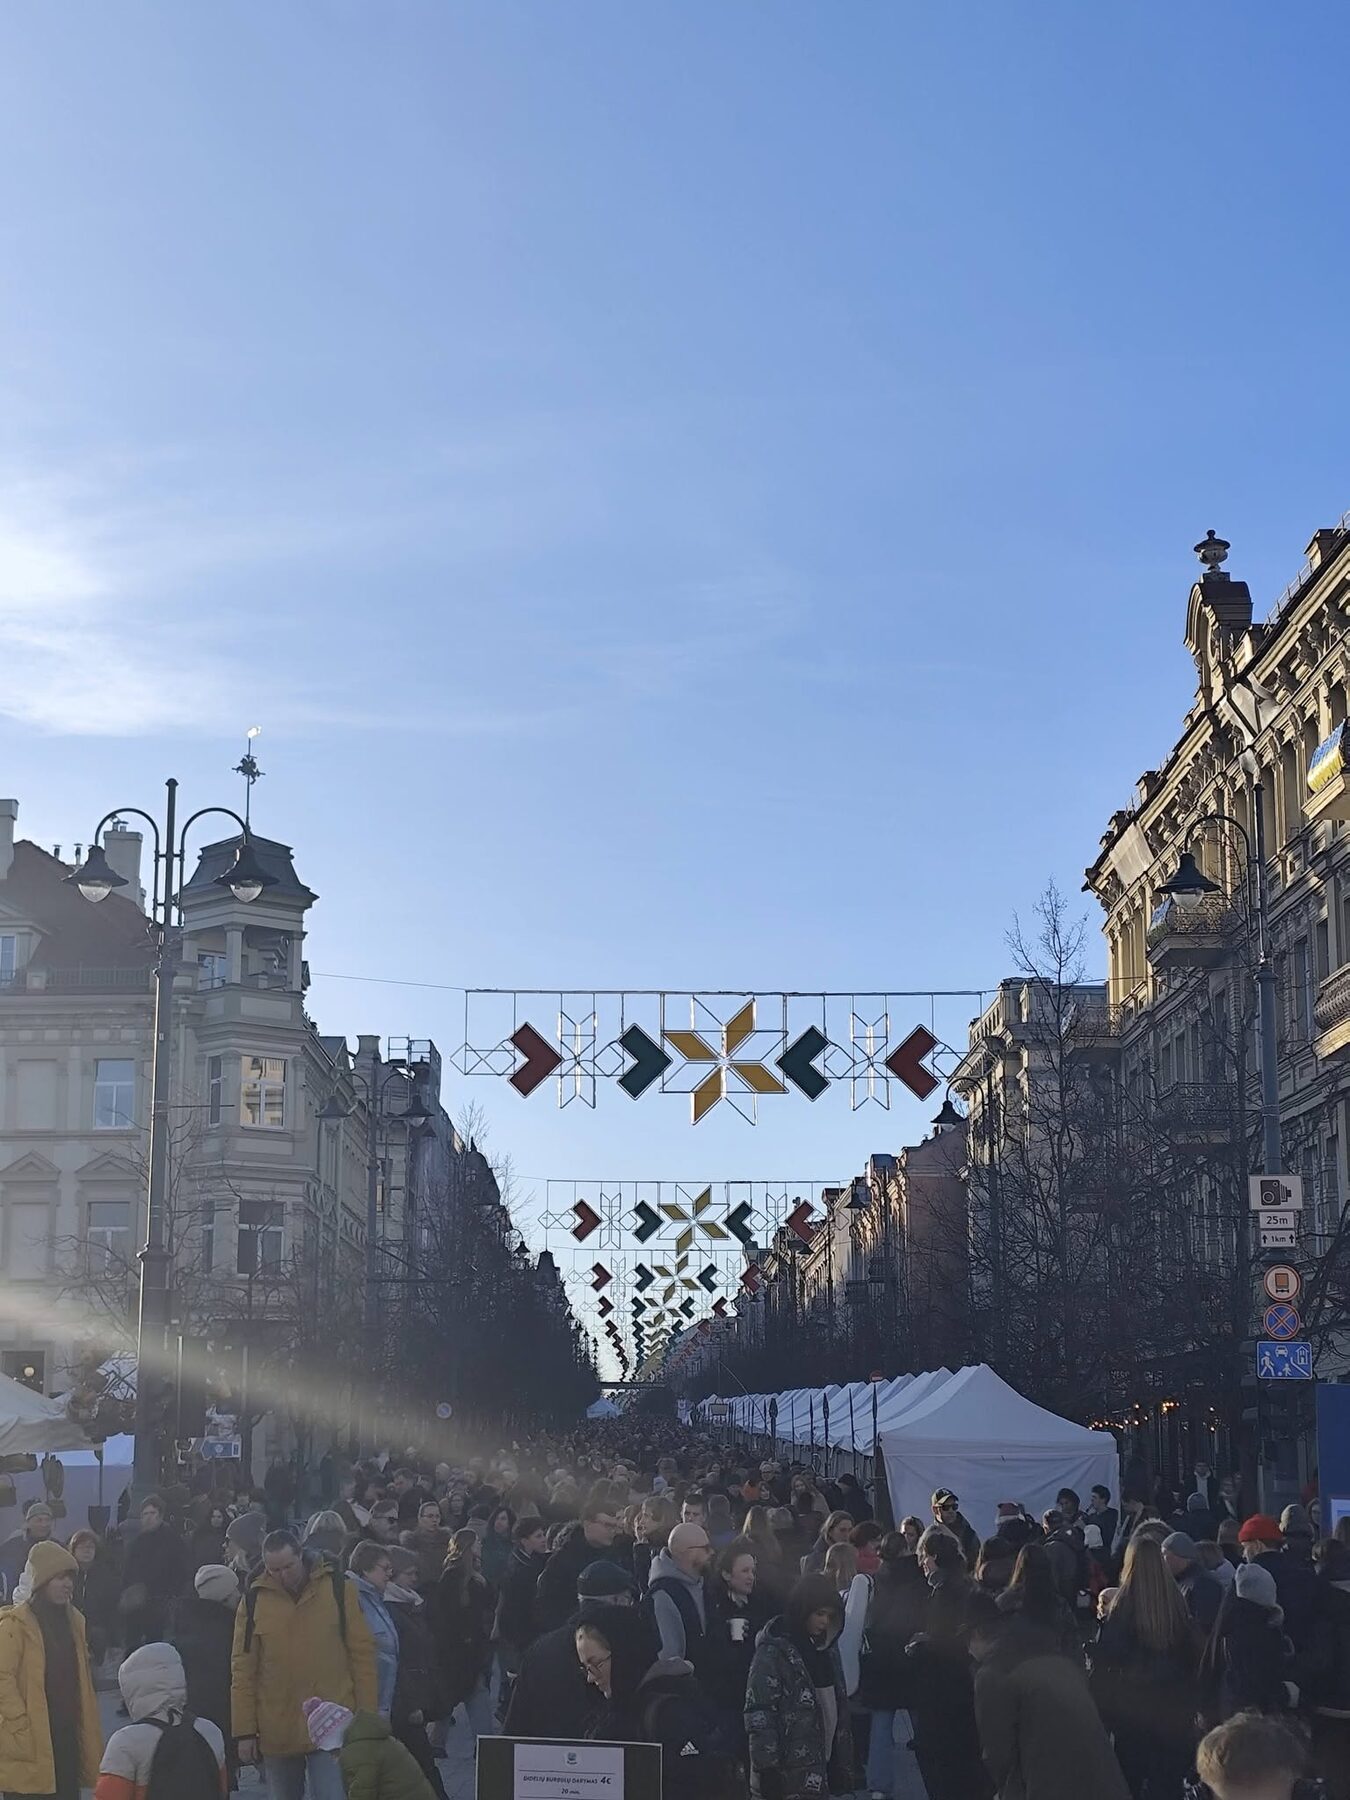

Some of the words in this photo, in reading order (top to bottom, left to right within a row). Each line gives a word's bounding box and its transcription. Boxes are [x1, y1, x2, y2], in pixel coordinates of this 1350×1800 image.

[1266, 1215, 1288, 1225] 25m
[1271, 1235, 1287, 1243] 1km
[561, 1787, 569, 1795] 20
